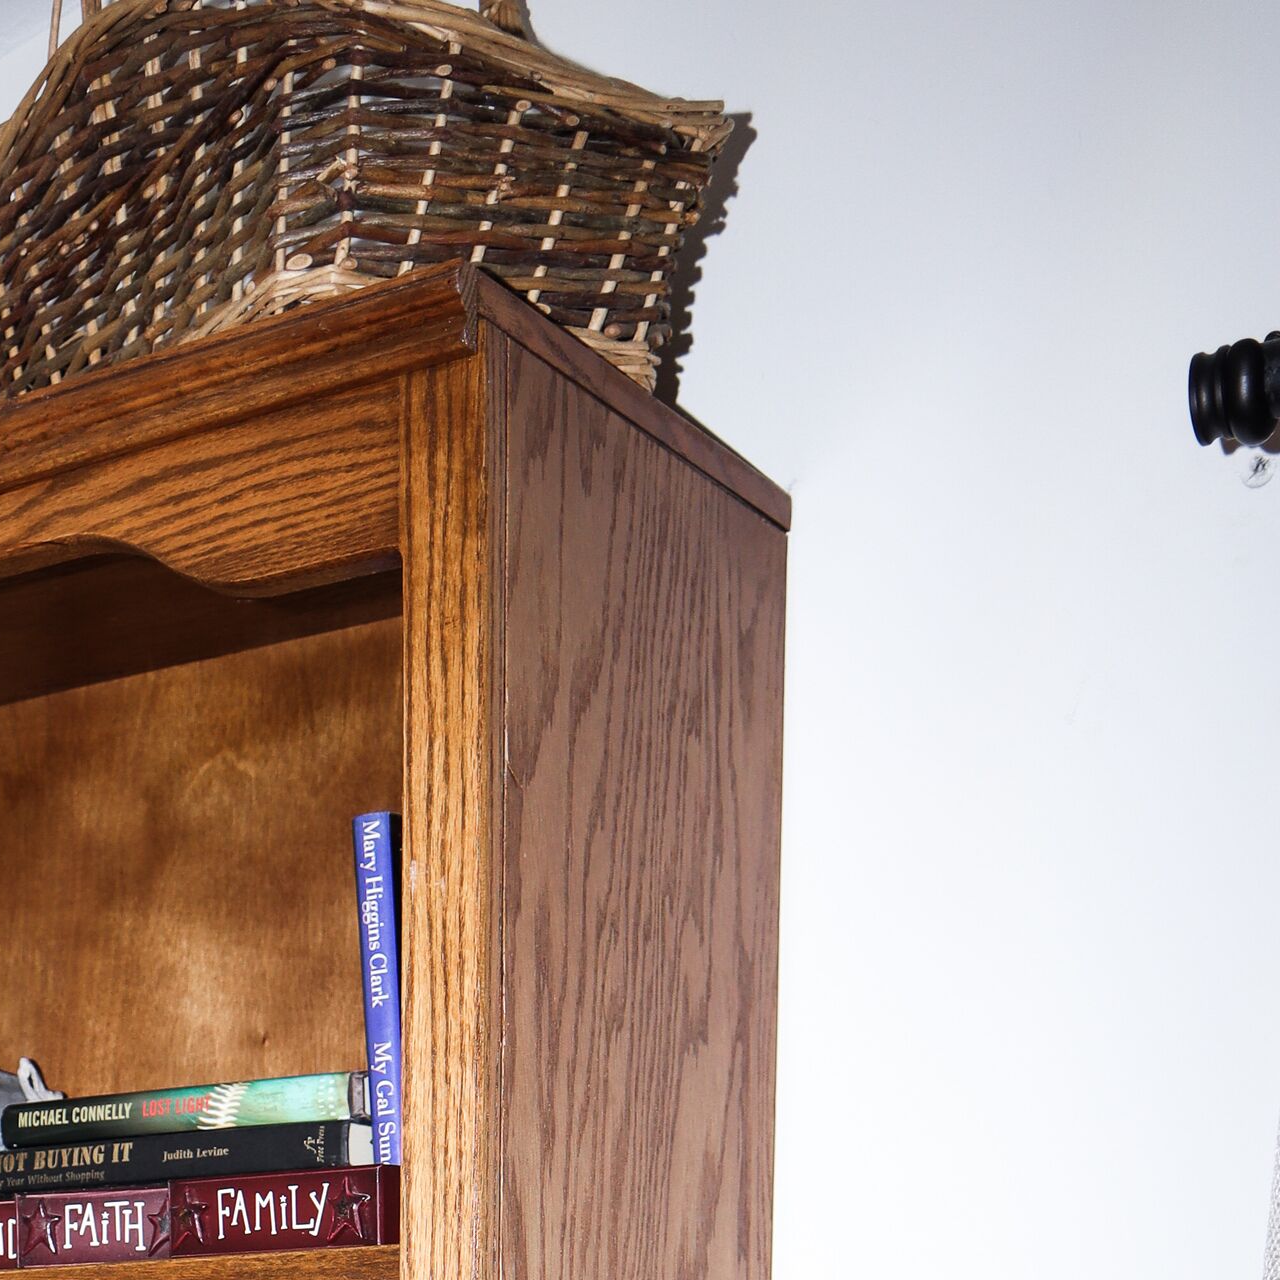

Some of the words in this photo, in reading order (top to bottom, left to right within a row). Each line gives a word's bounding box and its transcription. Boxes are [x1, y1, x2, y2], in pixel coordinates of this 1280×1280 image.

[360, 820, 380, 872] Mary
[361, 875, 384, 951] Higgins
[369, 953, 389, 1008] Clark
[371, 1041, 392, 1074] My
[18, 1108, 69, 1128] MICHAEL
[72, 1102, 133, 1123] CONNELLY
[142, 1100, 171, 1119] LOST
[175, 1095, 211, 1115] LIGHT
[376, 1080, 396, 1117] Gal
[34, 1144, 105, 1171] BUYING
[112, 1142, 133, 1163] IT
[163, 1149, 194, 1162] Judith
[197, 1146, 230, 1159] Levine
[7, 1175, 25, 1187] Year
[28, 1172, 63, 1186] Without
[65, 1169, 105, 1183] Shopping
